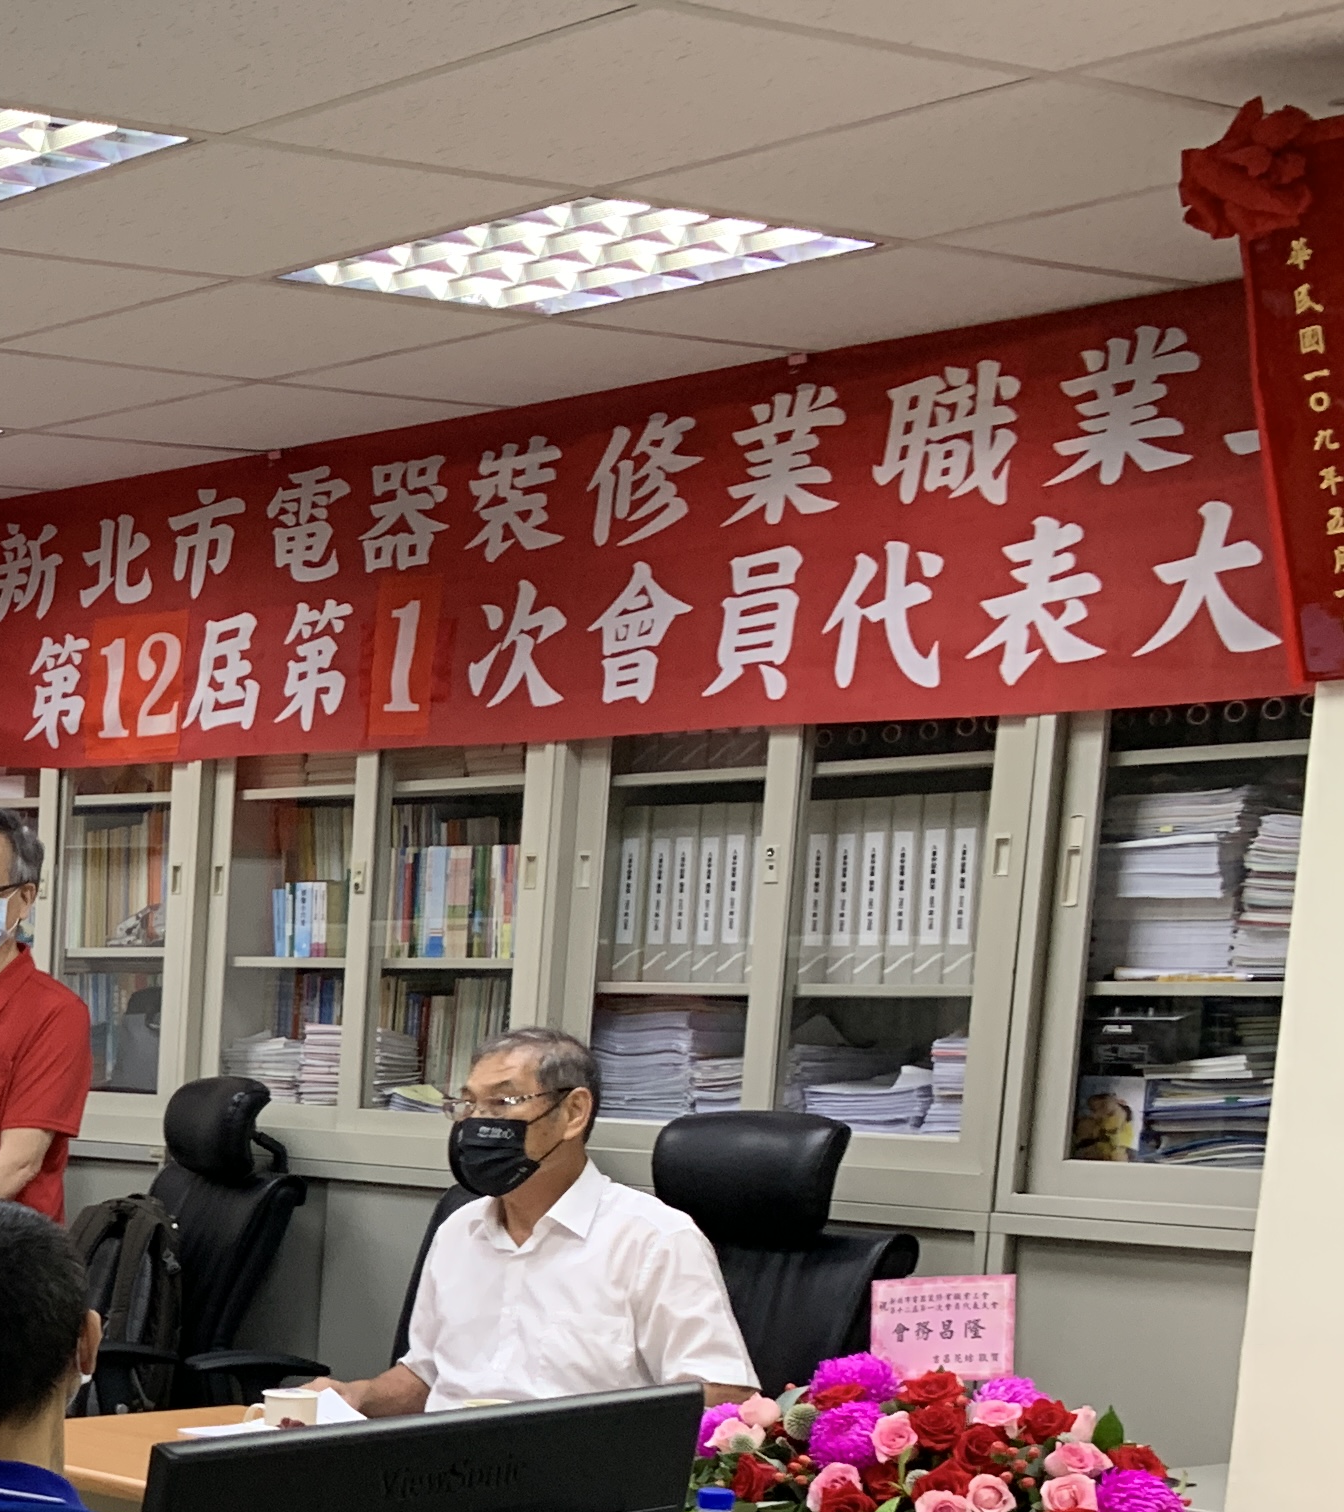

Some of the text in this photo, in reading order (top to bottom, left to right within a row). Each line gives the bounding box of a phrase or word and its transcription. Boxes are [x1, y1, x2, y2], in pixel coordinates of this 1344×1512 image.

[893, 1319, 986, 1342] 會務昌隆
[380, 1453, 527, 1499] ViewSonic
